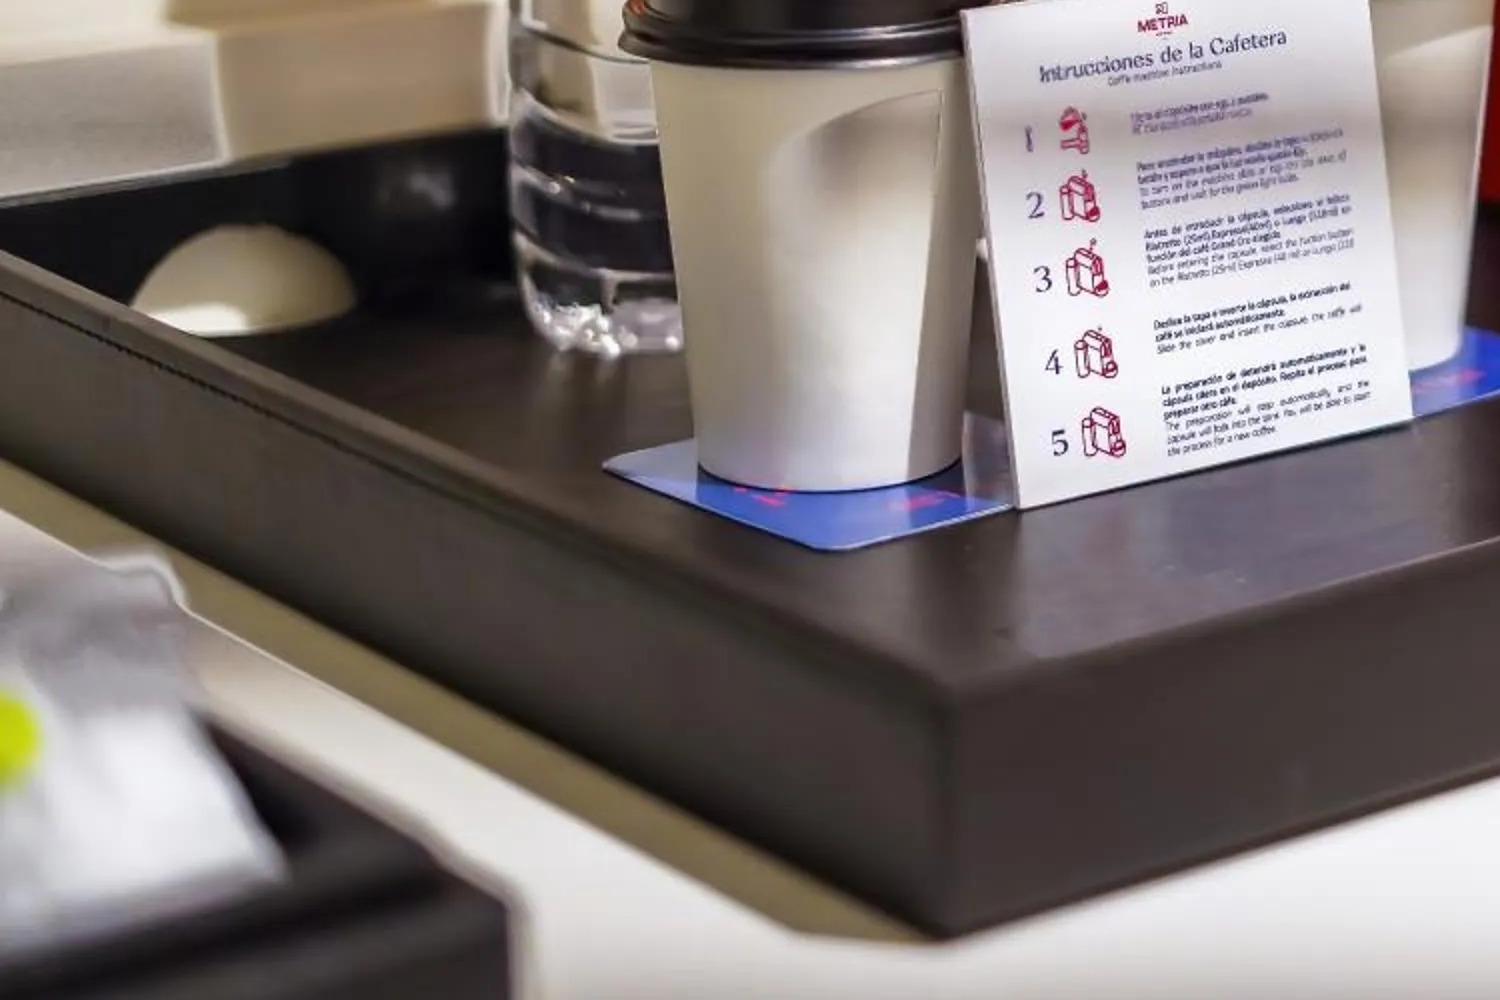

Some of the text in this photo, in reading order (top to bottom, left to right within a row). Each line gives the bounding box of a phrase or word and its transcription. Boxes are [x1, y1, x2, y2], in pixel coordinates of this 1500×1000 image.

[1137, 14, 1188, 33] METRIA
[1039, 32, 1287, 83] Intrucciones de la Cafetera
[1026, 191, 1045, 219] 2
[1033, 265, 1053, 293] 3
[1045, 349, 1063, 375] 4
[1161, 386, 1171, 396] La
[1051, 429, 1069, 457] 5
